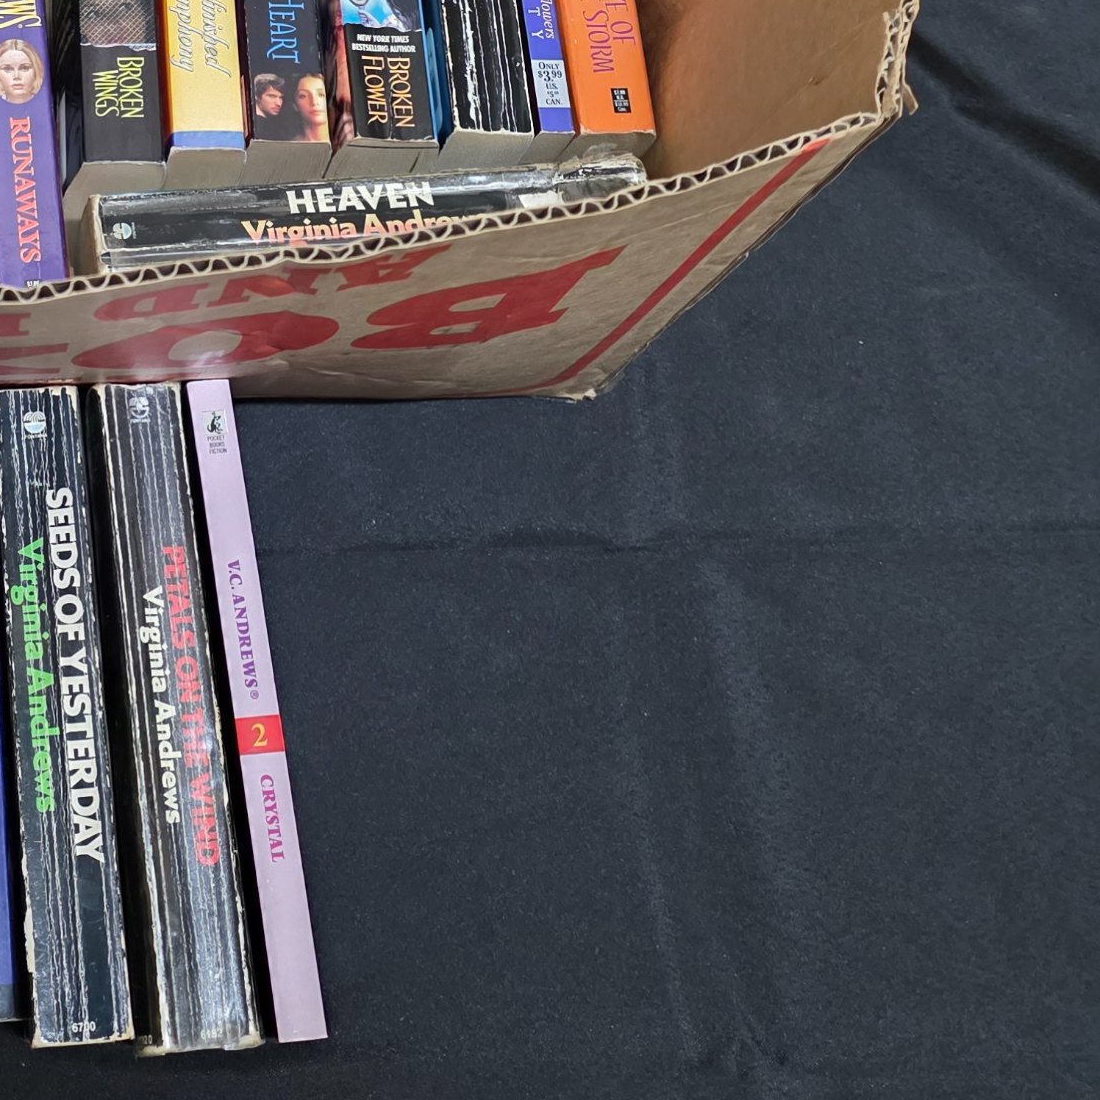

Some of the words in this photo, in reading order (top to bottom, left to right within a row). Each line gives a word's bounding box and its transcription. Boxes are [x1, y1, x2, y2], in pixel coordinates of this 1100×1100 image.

[351, 42, 389, 52] BESTSELLING
[390, 44, 416, 53] AUTHOR
[356, 33, 372, 41] NEW
[372, 34, 390, 42] YORK
[390, 35, 410, 43] TIMES
[582, 9, 616, 75] STORM
[609, 18, 636, 46] OF
[92, 69, 119, 118] WINGS
[116, 56, 145, 118] BROKEN
[361, 54, 389, 125] FLOWER
[387, 57, 416, 128] BROKEN
[545, 98, 563, 106] CAN.
[9, 116, 42, 265] RUNAWAYS
[286, 180, 435, 215] HEAVEN
[240, 216, 358, 248] Virginia
[46, 487, 81, 590] SEEDS
[11, 537, 50, 661] Virginia
[162, 546, 196, 649] PETALS
[227, 559, 243, 590] V.C.
[53, 593, 86, 641] OF
[139, 585, 172, 694] Virginia
[232, 593, 259, 689] ANDREWS
[175, 656, 202, 703] ON
[26, 666, 60, 814] Andrews
[59, 646, 105, 864] YESTERDAY
[153, 699, 183, 825] Andrews
[179, 706, 209, 768] THE
[251, 723, 268, 747] 2
[188, 771, 220, 866] WIND
[260, 773, 285, 863] CRYSTAL
[71, 1020, 96, 1034] 6700
